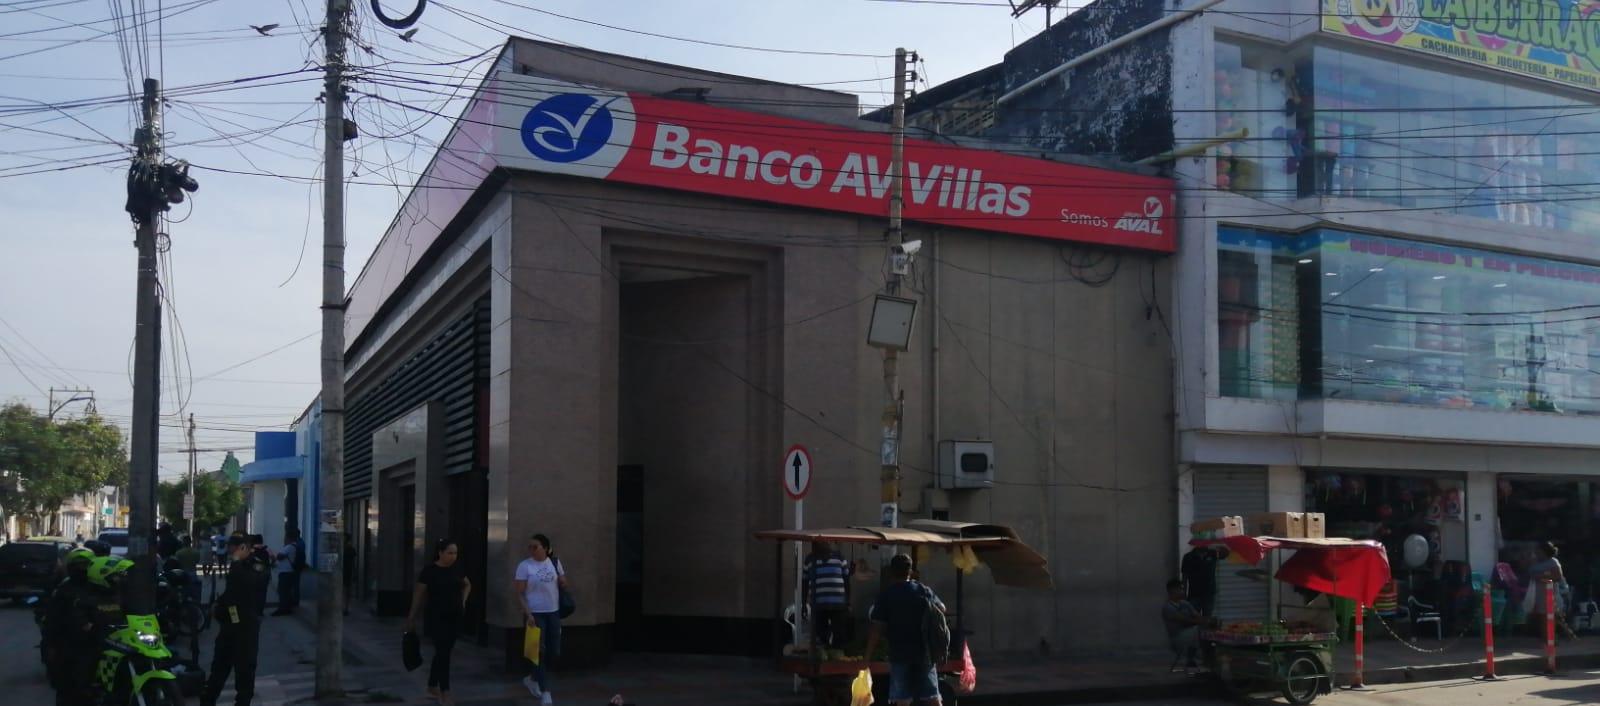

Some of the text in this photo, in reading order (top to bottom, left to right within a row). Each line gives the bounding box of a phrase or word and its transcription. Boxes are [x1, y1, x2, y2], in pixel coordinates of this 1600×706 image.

[650, 121, 1032, 217] Banco AV Villas
[1061, 208, 1109, 228] Somos
[1114, 217, 1163, 235] AVAL
